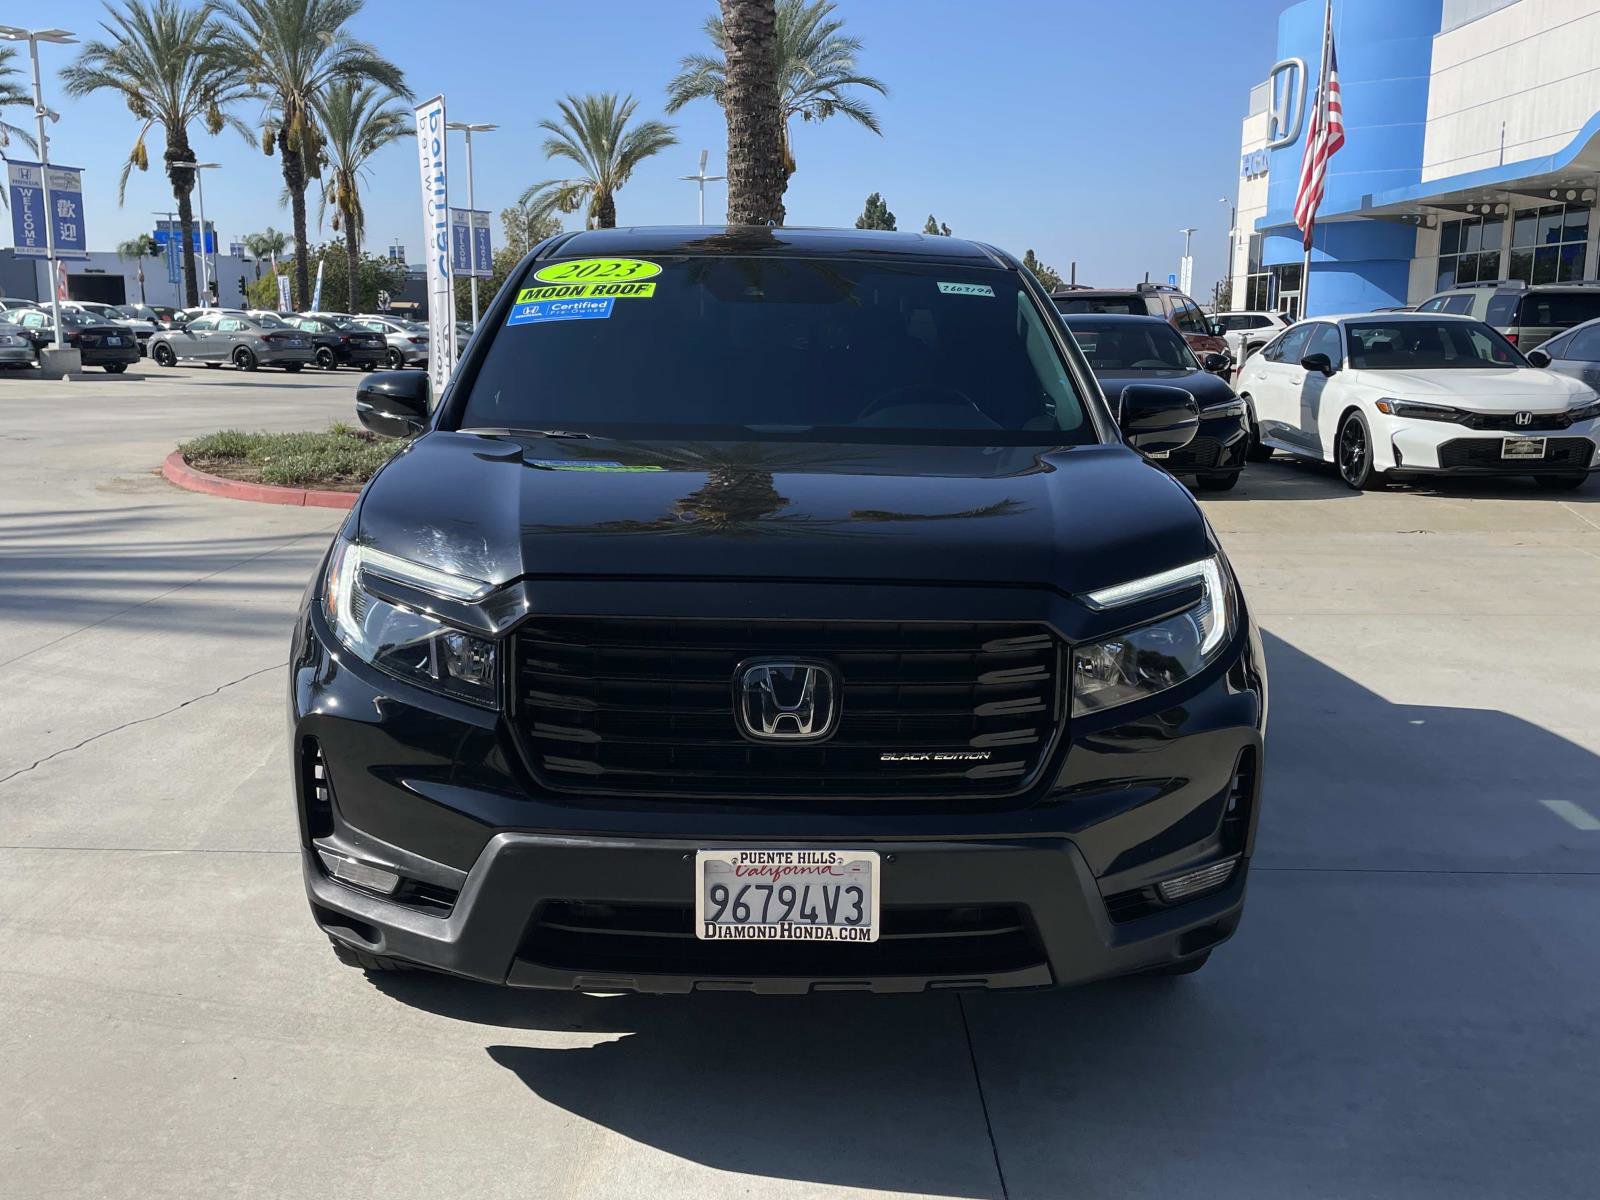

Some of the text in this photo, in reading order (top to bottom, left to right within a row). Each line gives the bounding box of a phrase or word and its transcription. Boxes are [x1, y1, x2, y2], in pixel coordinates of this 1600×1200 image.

[18, 187, 36, 246] WELCOME
[456, 226, 466, 269] WELCOME
[553, 262, 643, 280] 2023
[522, 283, 651, 300] MOON ROOF
[551, 301, 608, 311] Certified
[880, 751, 992, 761] BLACK EDITION
[740, 851, 837, 865] PUENTE HILLS
[735, 865, 844, 882] California
[709, 884, 865, 925] 96794V3
